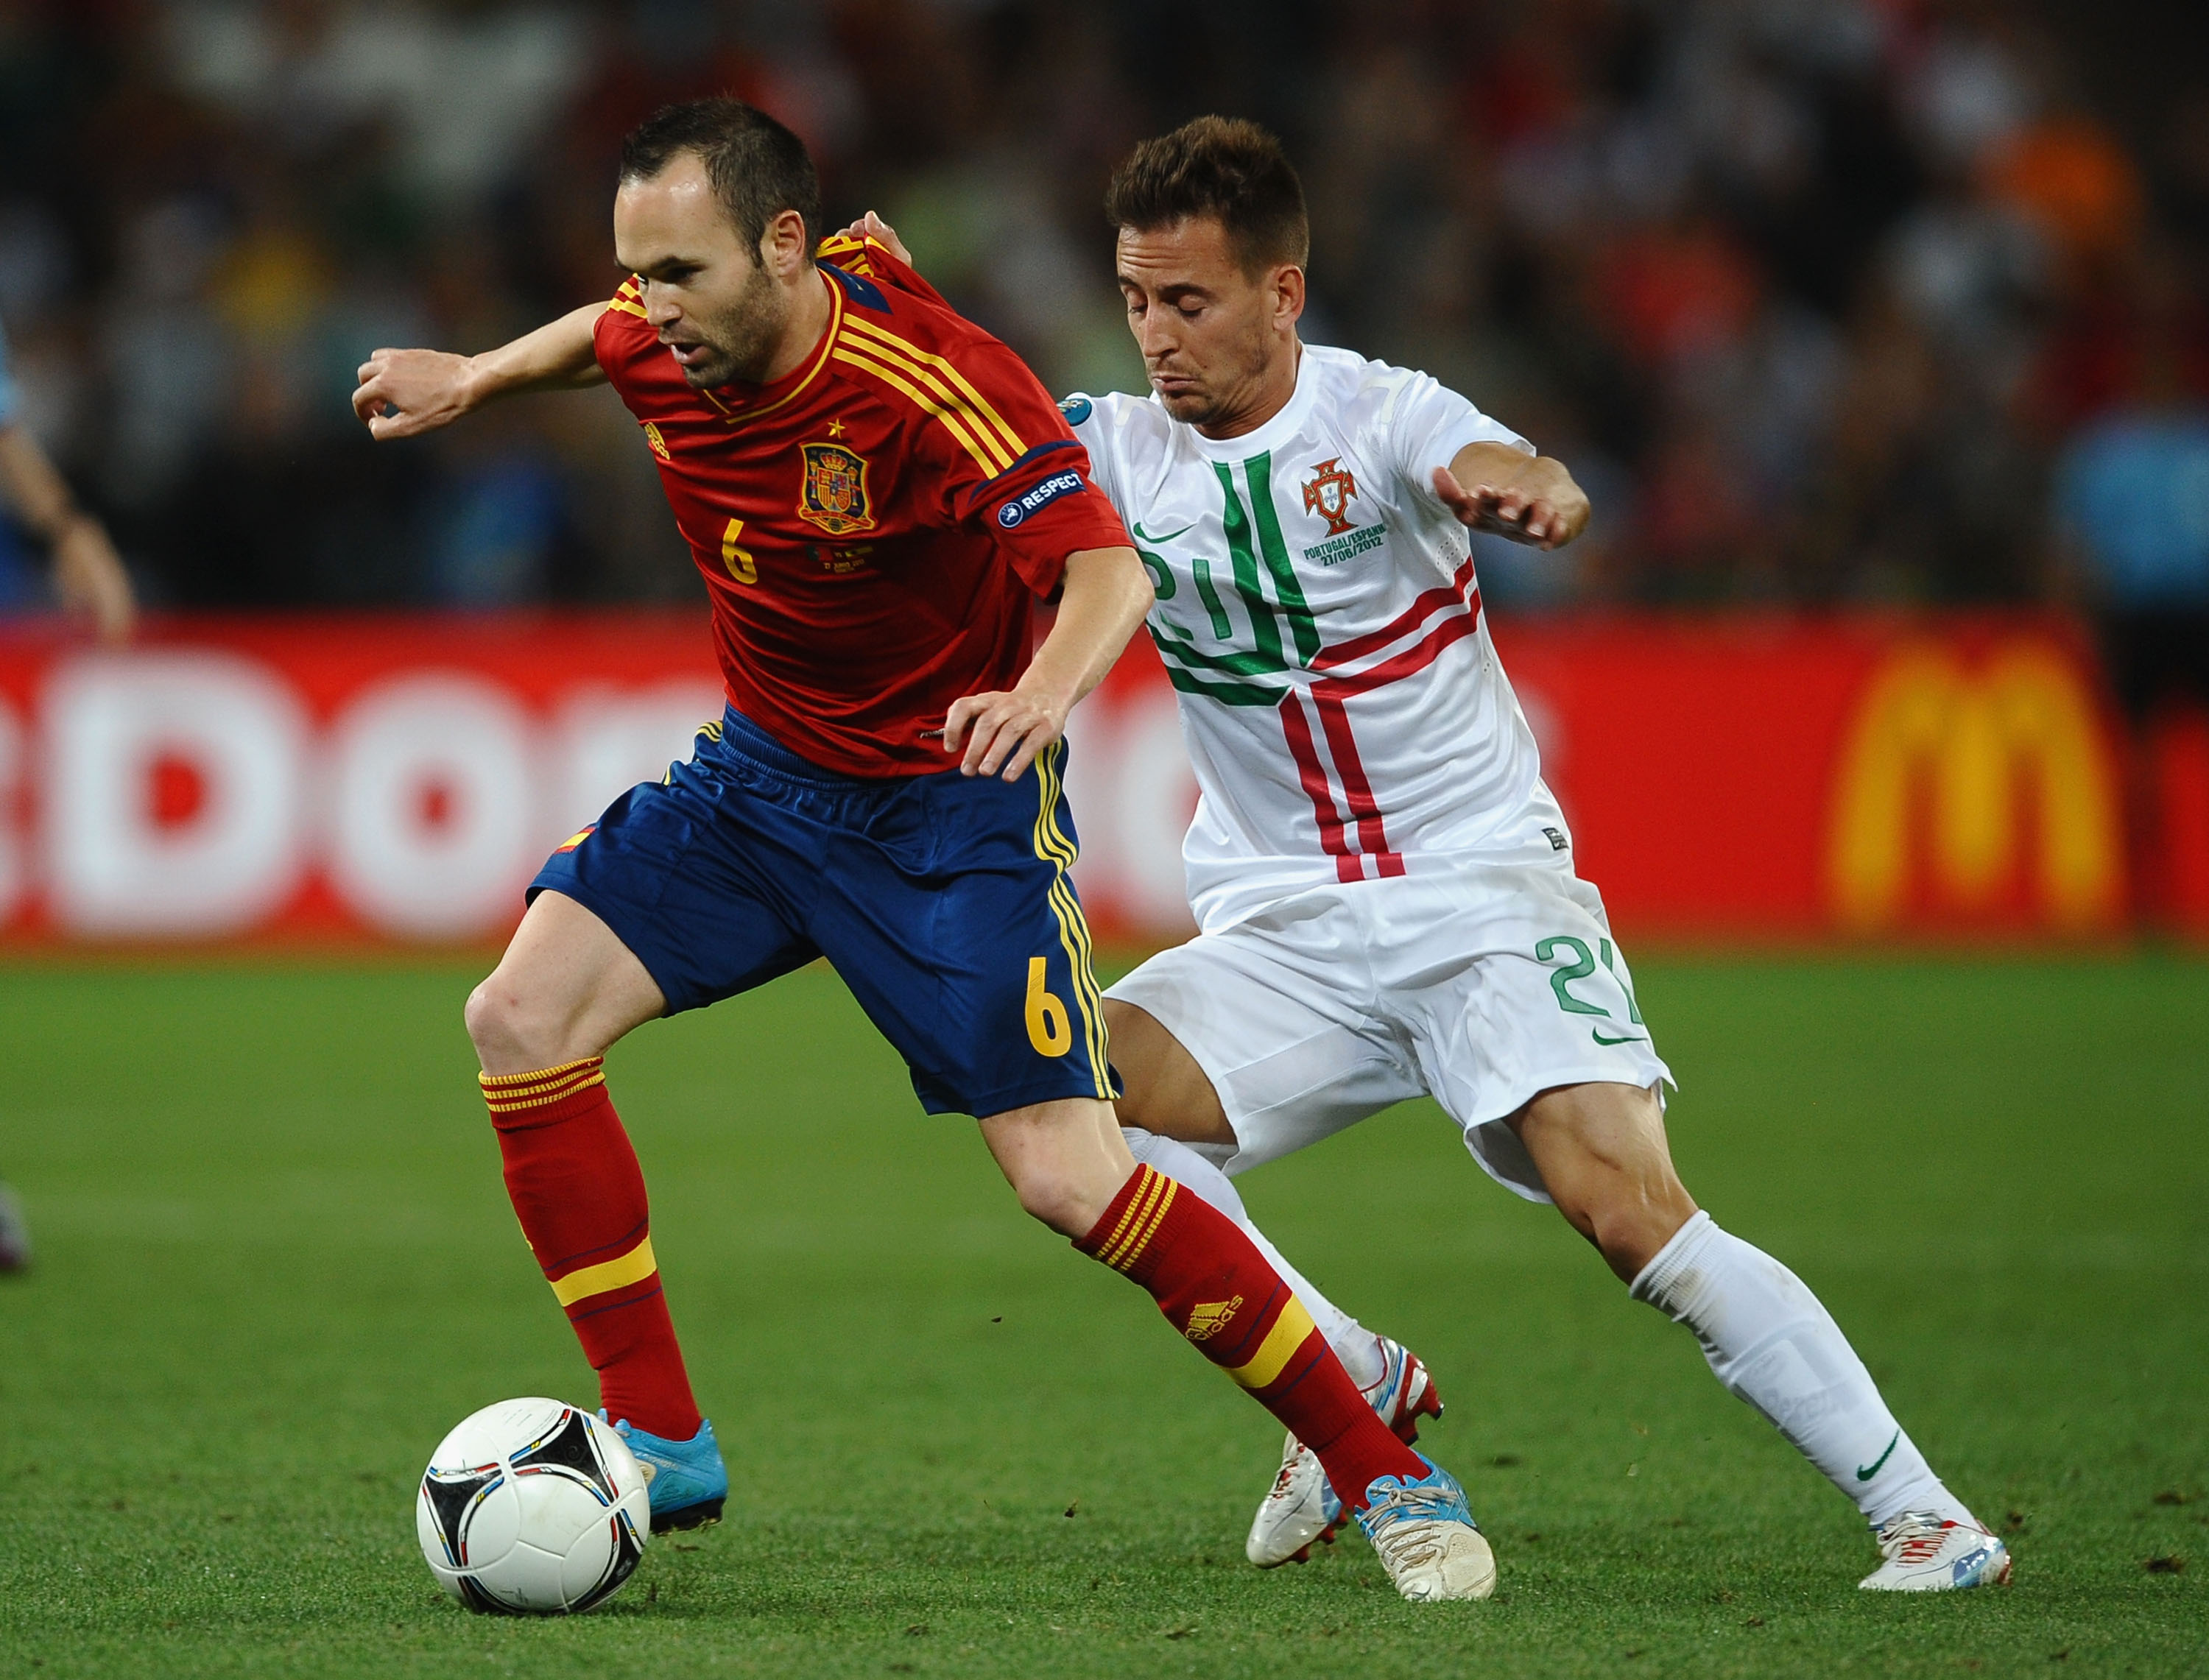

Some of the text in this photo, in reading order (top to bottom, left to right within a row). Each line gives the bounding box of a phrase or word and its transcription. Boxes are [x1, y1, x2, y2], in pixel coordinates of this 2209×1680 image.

[1021, 473, 1084, 509] RESPECT
[722, 518, 758, 585] 6
[1303, 522, 1387, 560] PORTUGAL/ESPANH
[1320, 536, 1384, 567] 27/06/2012
[1024, 956, 1072, 1057] 6
